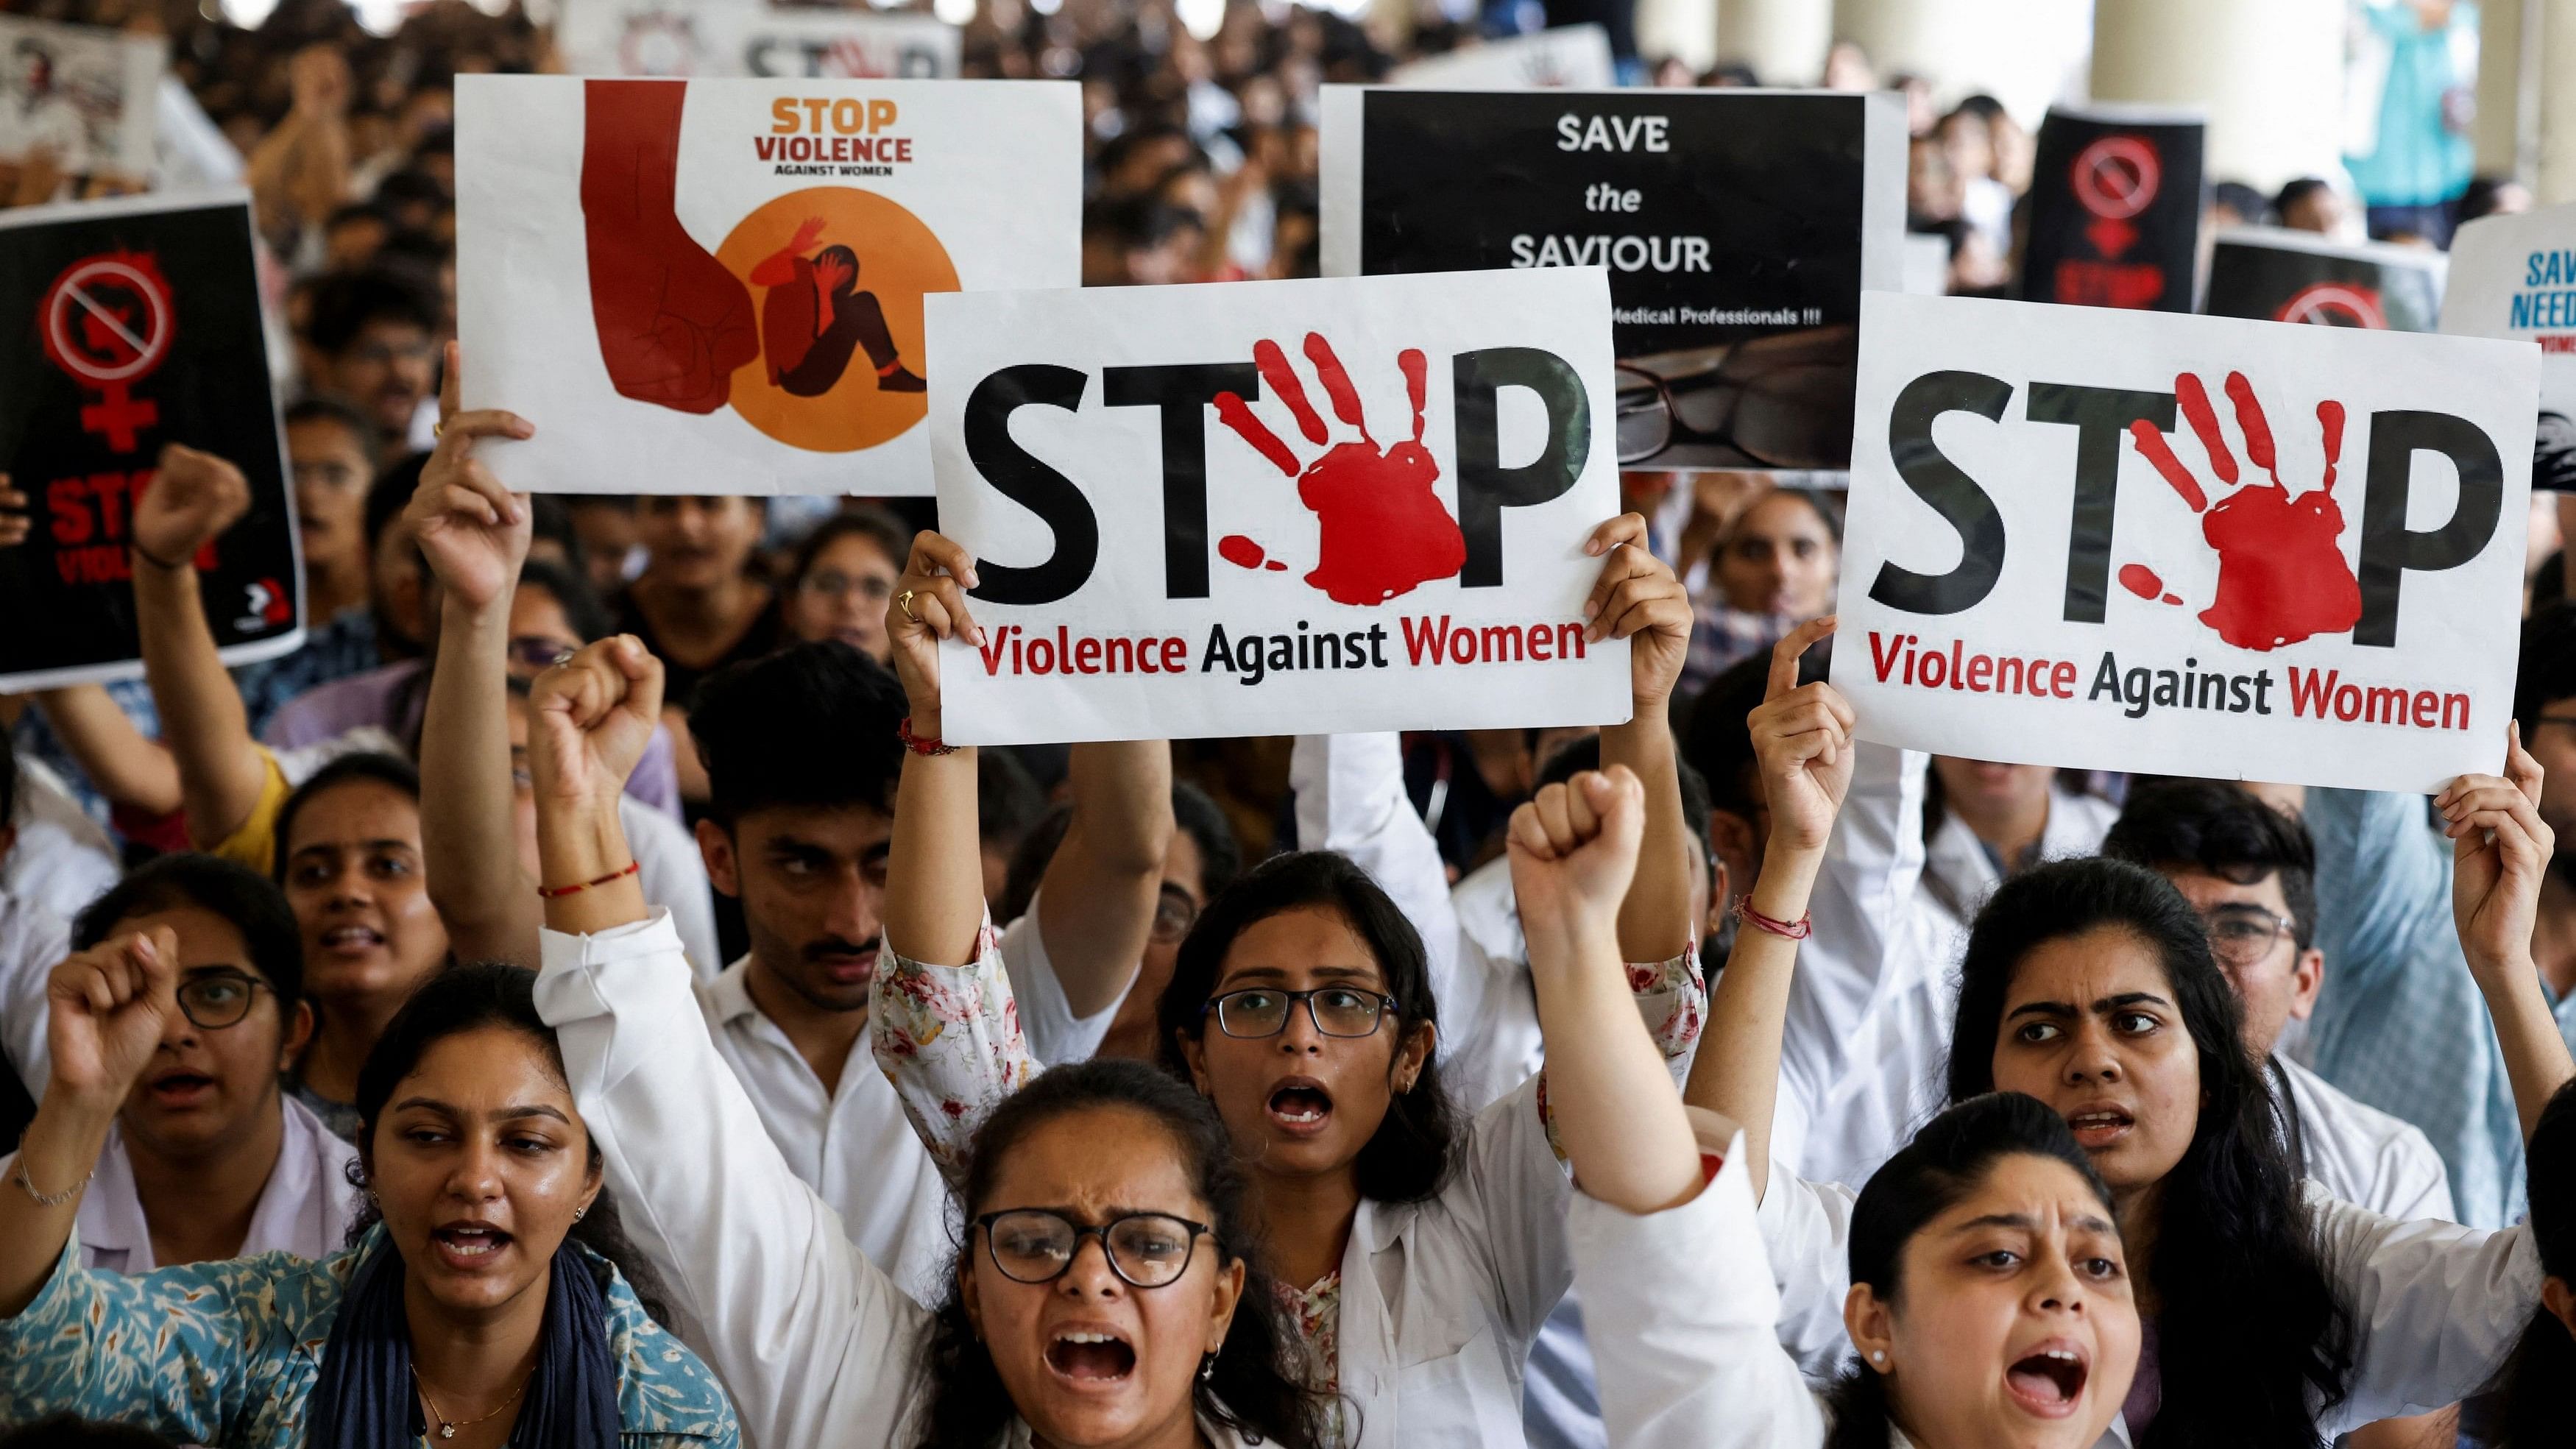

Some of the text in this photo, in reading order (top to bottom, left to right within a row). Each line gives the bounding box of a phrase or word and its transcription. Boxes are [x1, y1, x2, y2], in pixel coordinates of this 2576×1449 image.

[771, 97, 898, 135] STOP
[1557, 114, 1671, 152] SAVE
[754, 137, 913, 163] VIOLENCE
[774, 165, 893, 177] AGAINST WOMEN
[1585, 183, 1643, 213] the
[1510, 234, 1713, 273] SAVIOUR
[1680, 307, 1799, 326] Professionals
[1803, 308, 1822, 326] !!!
[963, 331, 1592, 606] STP
[1867, 369, 2504, 653] STP
[977, 615, 1586, 687] Violence Against Women
[1868, 631, 2471, 731] Violence Against Women
